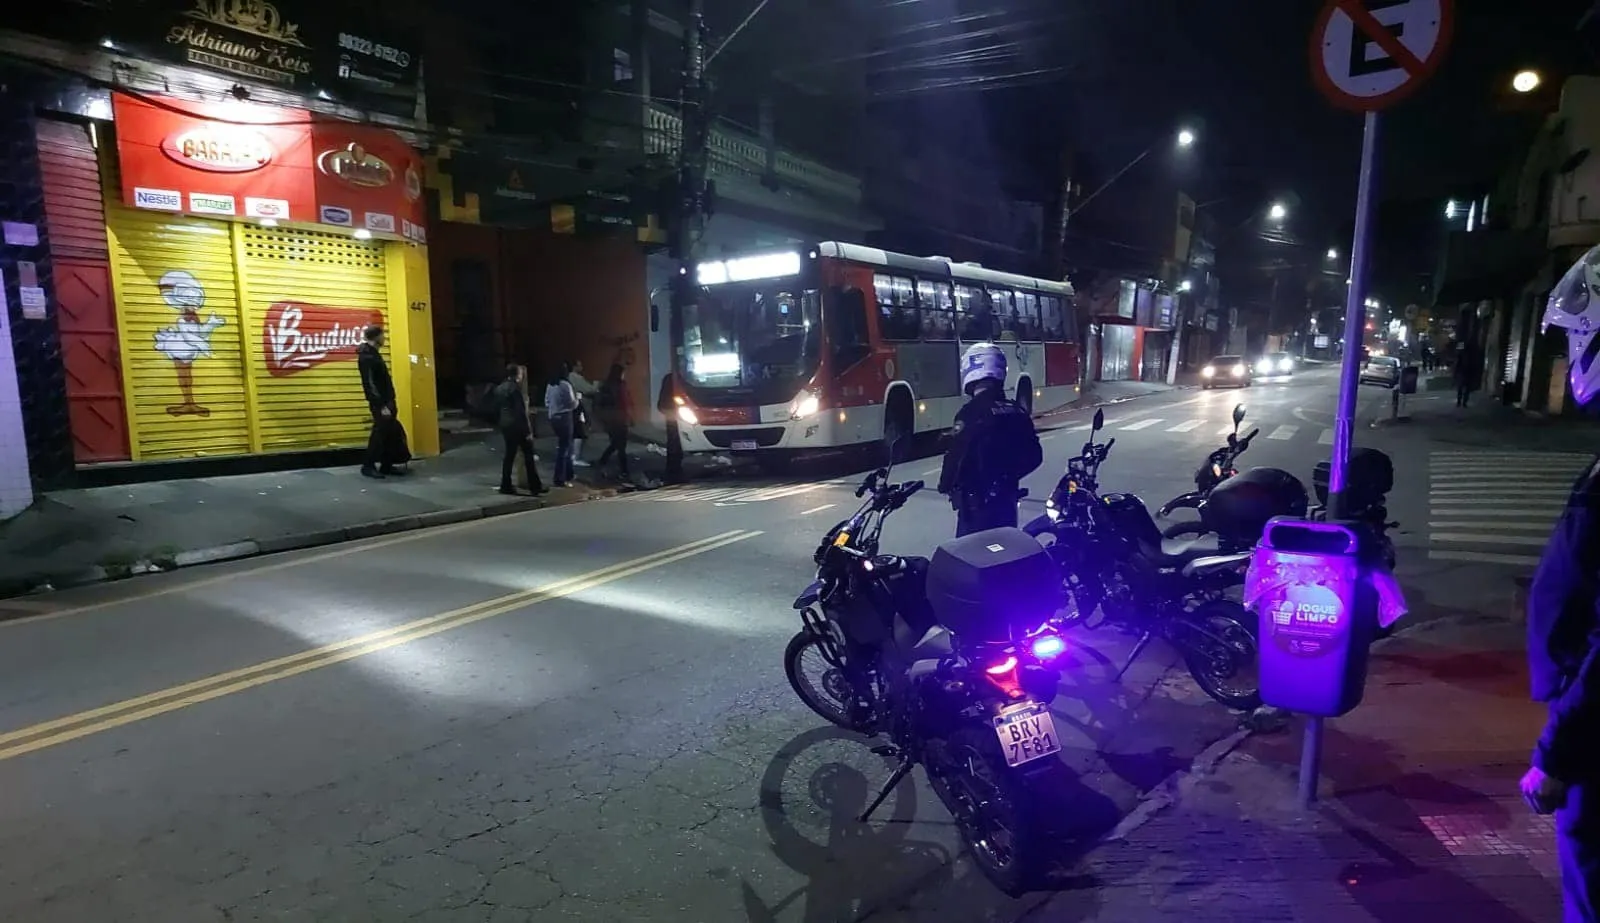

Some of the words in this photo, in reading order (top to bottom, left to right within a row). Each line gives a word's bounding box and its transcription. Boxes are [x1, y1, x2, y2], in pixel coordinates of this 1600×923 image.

[165, 23, 261, 60] Adriana
[410, 301, 426, 313] 447
[1296, 602, 1337, 615] JOGUE
[1296, 611, 1338, 624] LIMPO
[1009, 716, 1041, 742] BRY
[1009, 732, 1058, 762] 7F81
